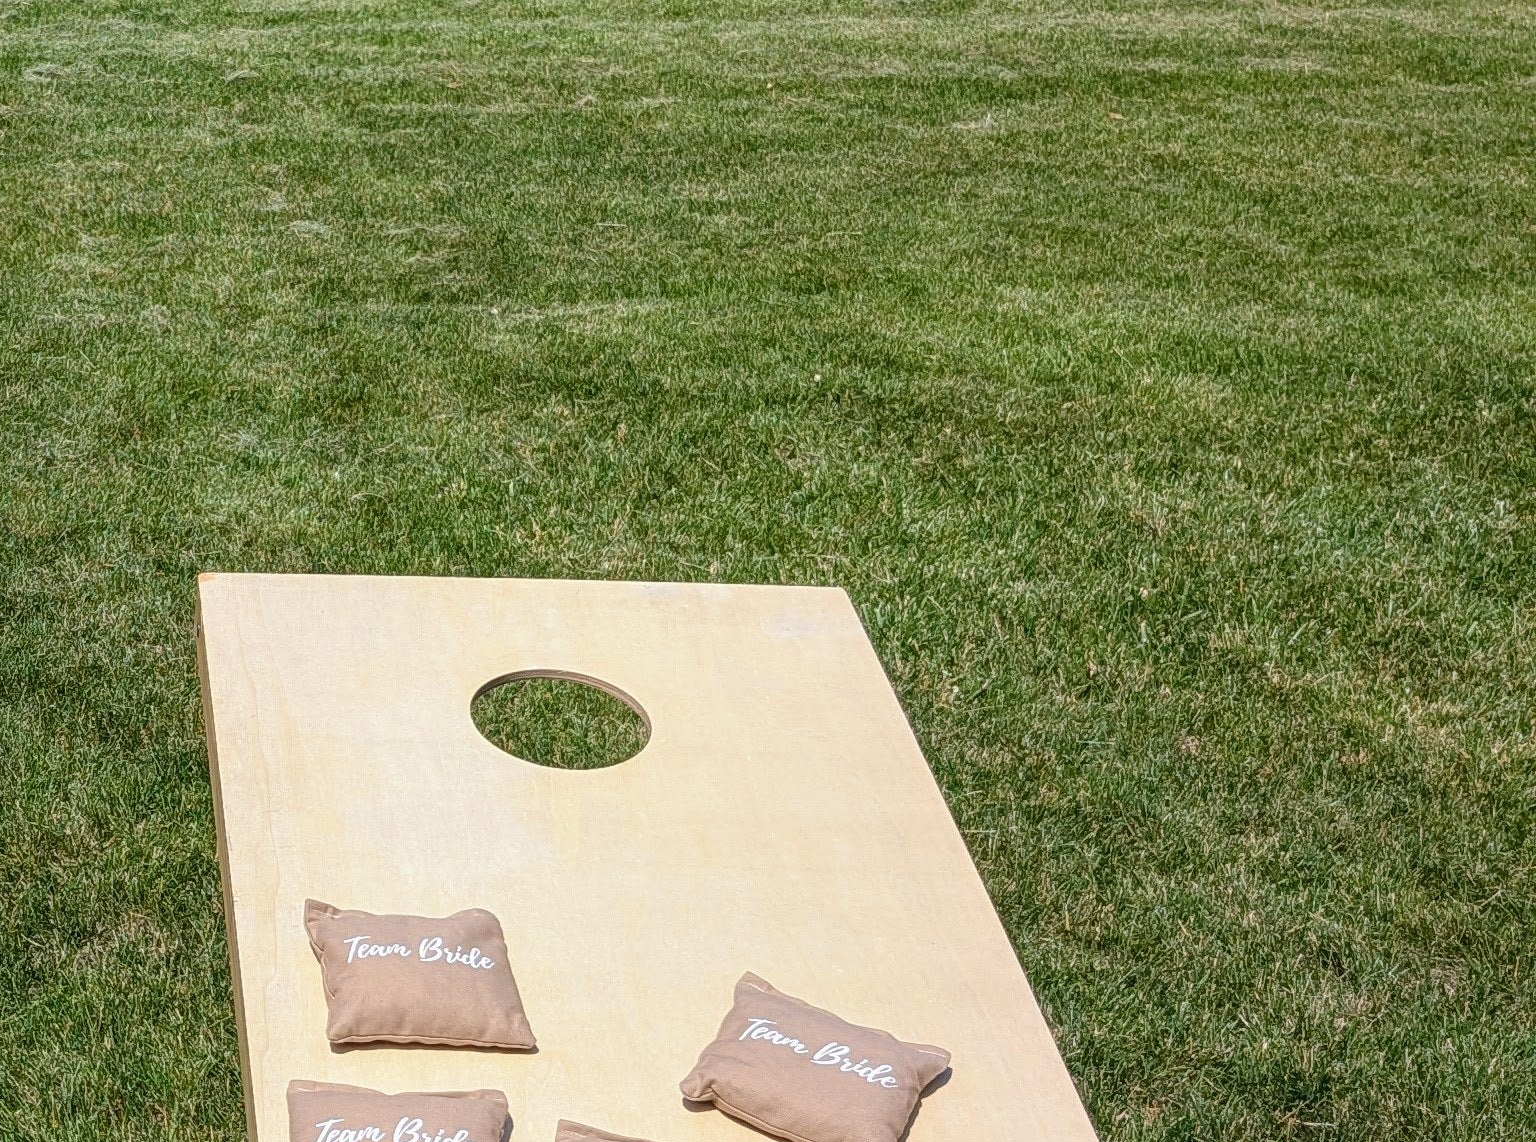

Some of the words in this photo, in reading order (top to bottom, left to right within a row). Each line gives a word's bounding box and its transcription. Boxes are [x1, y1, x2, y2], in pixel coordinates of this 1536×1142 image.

[343, 935, 412, 964] Team
[418, 936, 495, 969] Bride
[738, 1018, 809, 1055] Team
[810, 1041, 898, 1088] Bride
